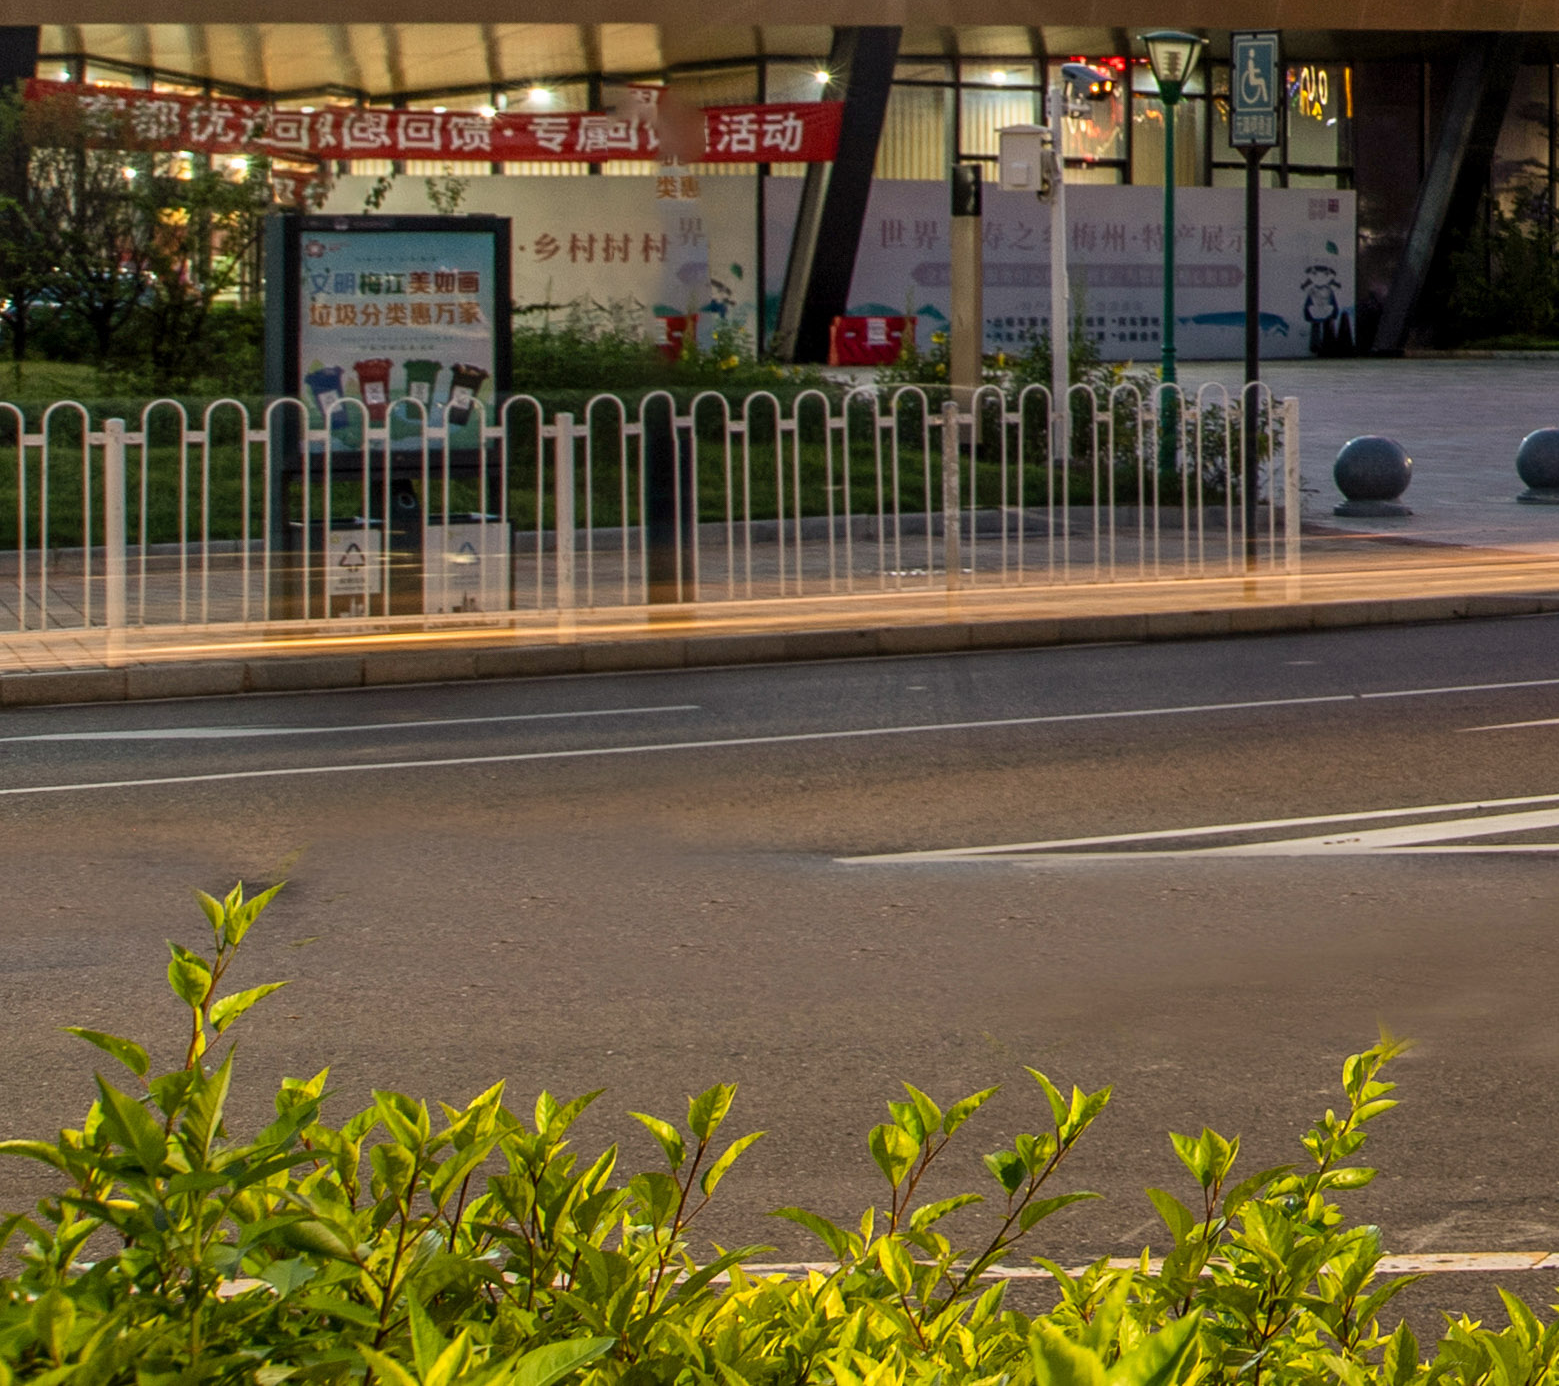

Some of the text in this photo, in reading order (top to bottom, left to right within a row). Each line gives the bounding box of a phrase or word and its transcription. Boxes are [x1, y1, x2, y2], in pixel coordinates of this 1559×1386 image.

[310, 270, 481, 296] 文明梅江美如画
[308, 301, 482, 327] 垃圾分类惠万家
